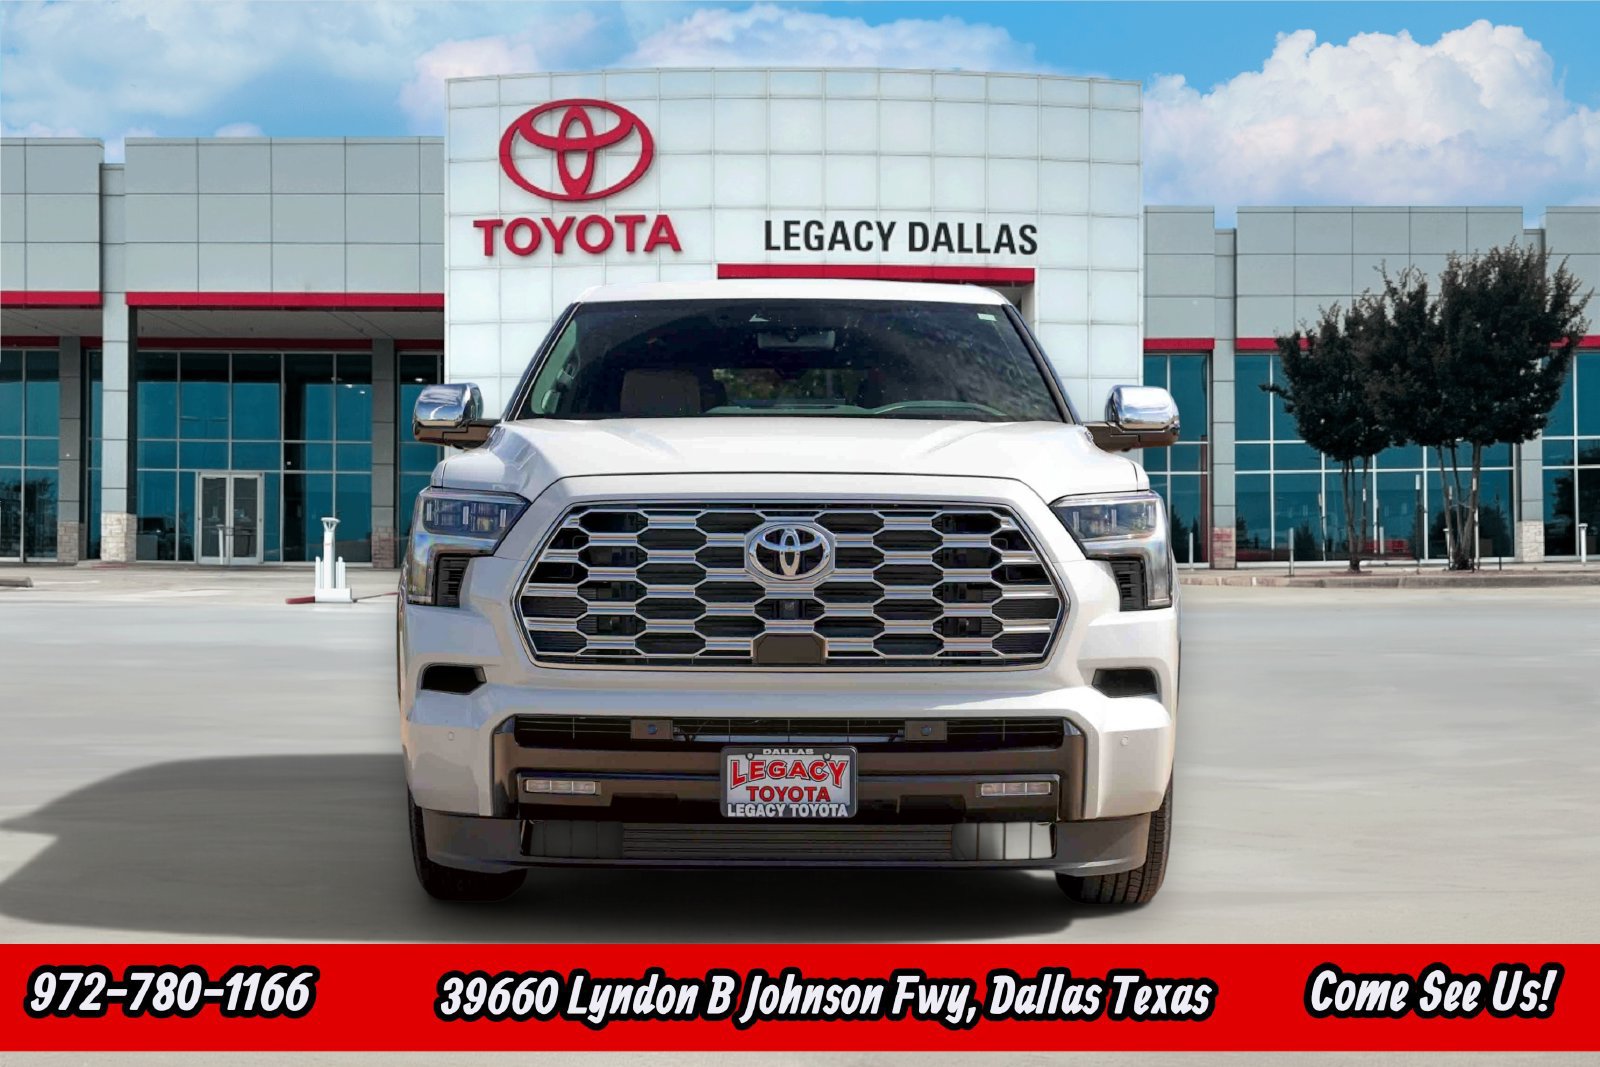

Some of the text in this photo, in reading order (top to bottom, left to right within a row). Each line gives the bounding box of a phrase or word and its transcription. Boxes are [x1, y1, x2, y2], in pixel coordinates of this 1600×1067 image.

[473, 214, 682, 257] TOYOTA
[765, 220, 1038, 255] LEGACY DALLAS
[730, 759, 849, 789] LEGACY
[746, 785, 831, 802] TOYOTA
[727, 803, 849, 817] LEGACY TOYOTA
